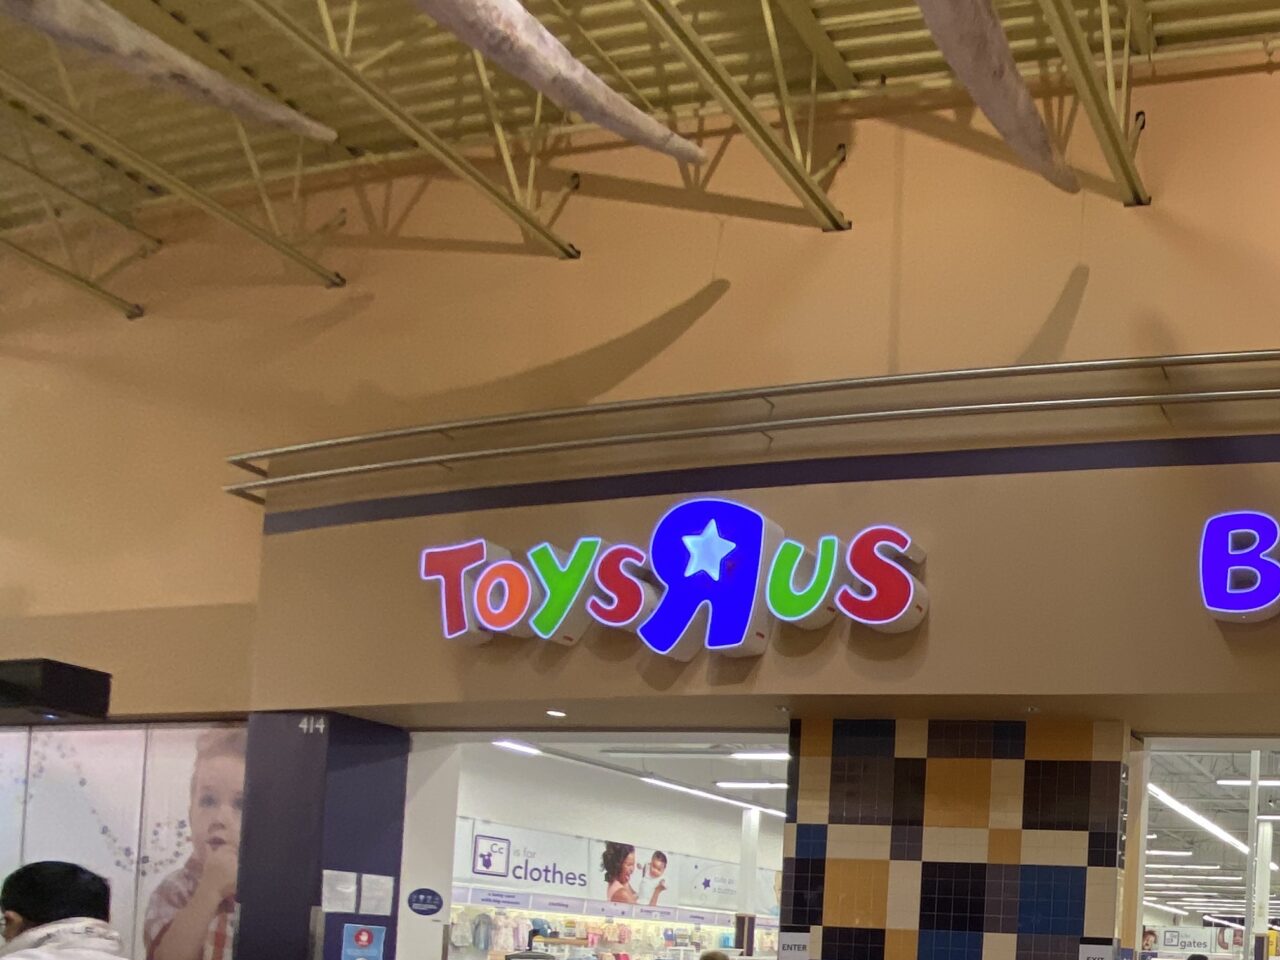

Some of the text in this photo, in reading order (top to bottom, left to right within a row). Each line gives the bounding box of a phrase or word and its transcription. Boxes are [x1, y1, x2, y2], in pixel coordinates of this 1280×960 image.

[298, 717, 325, 734] 414
[512, 859, 587, 887] clothes
[782, 943, 807, 951] ENTER
[1180, 940, 1208, 949] gates
